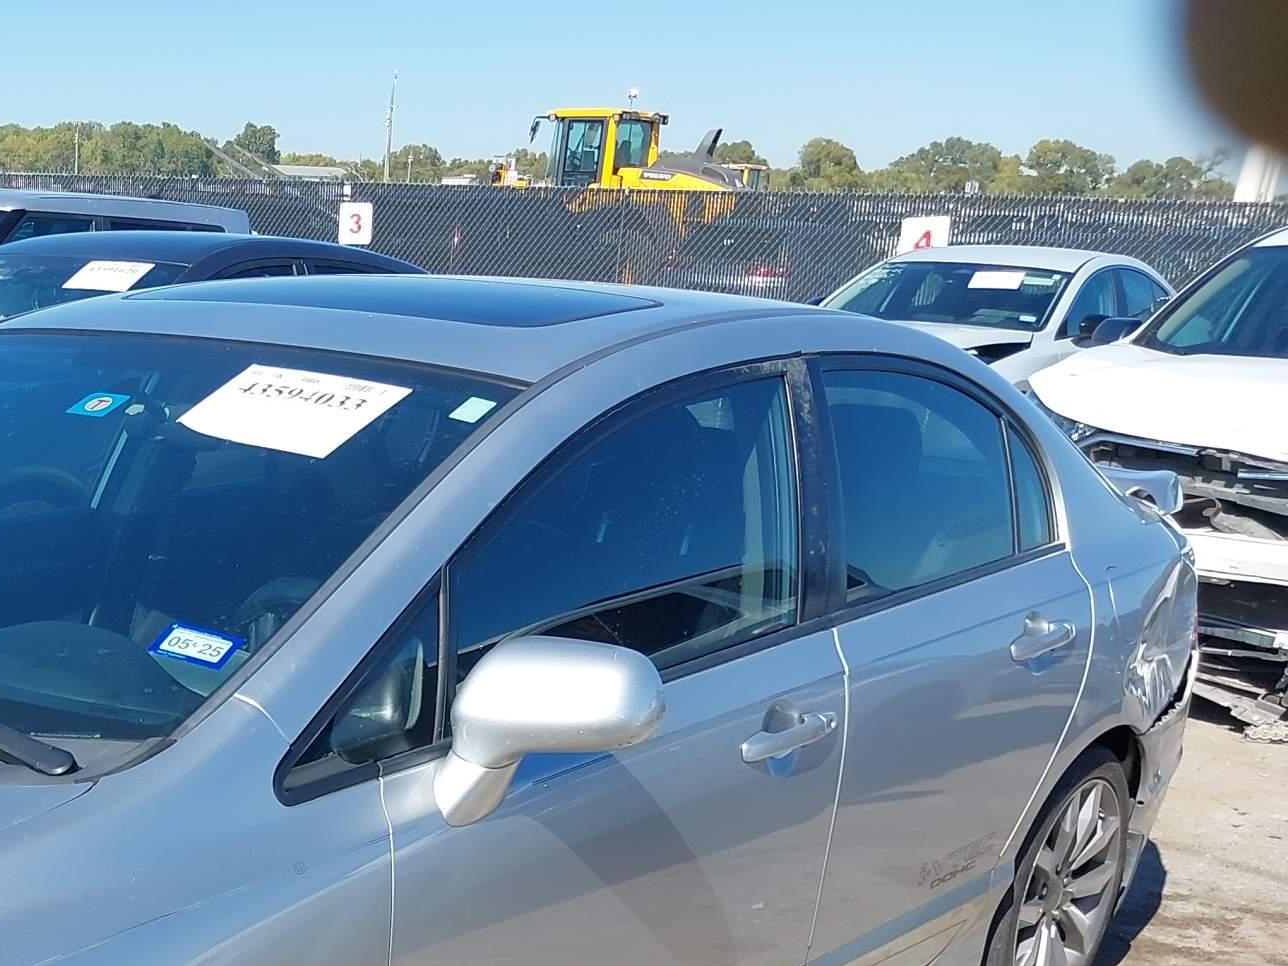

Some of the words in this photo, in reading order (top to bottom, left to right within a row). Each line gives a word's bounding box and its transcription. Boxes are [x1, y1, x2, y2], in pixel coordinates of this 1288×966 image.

[349, 213, 362, 234] 3
[167, 636, 190, 650] 05
[196, 643, 224, 658] 25
